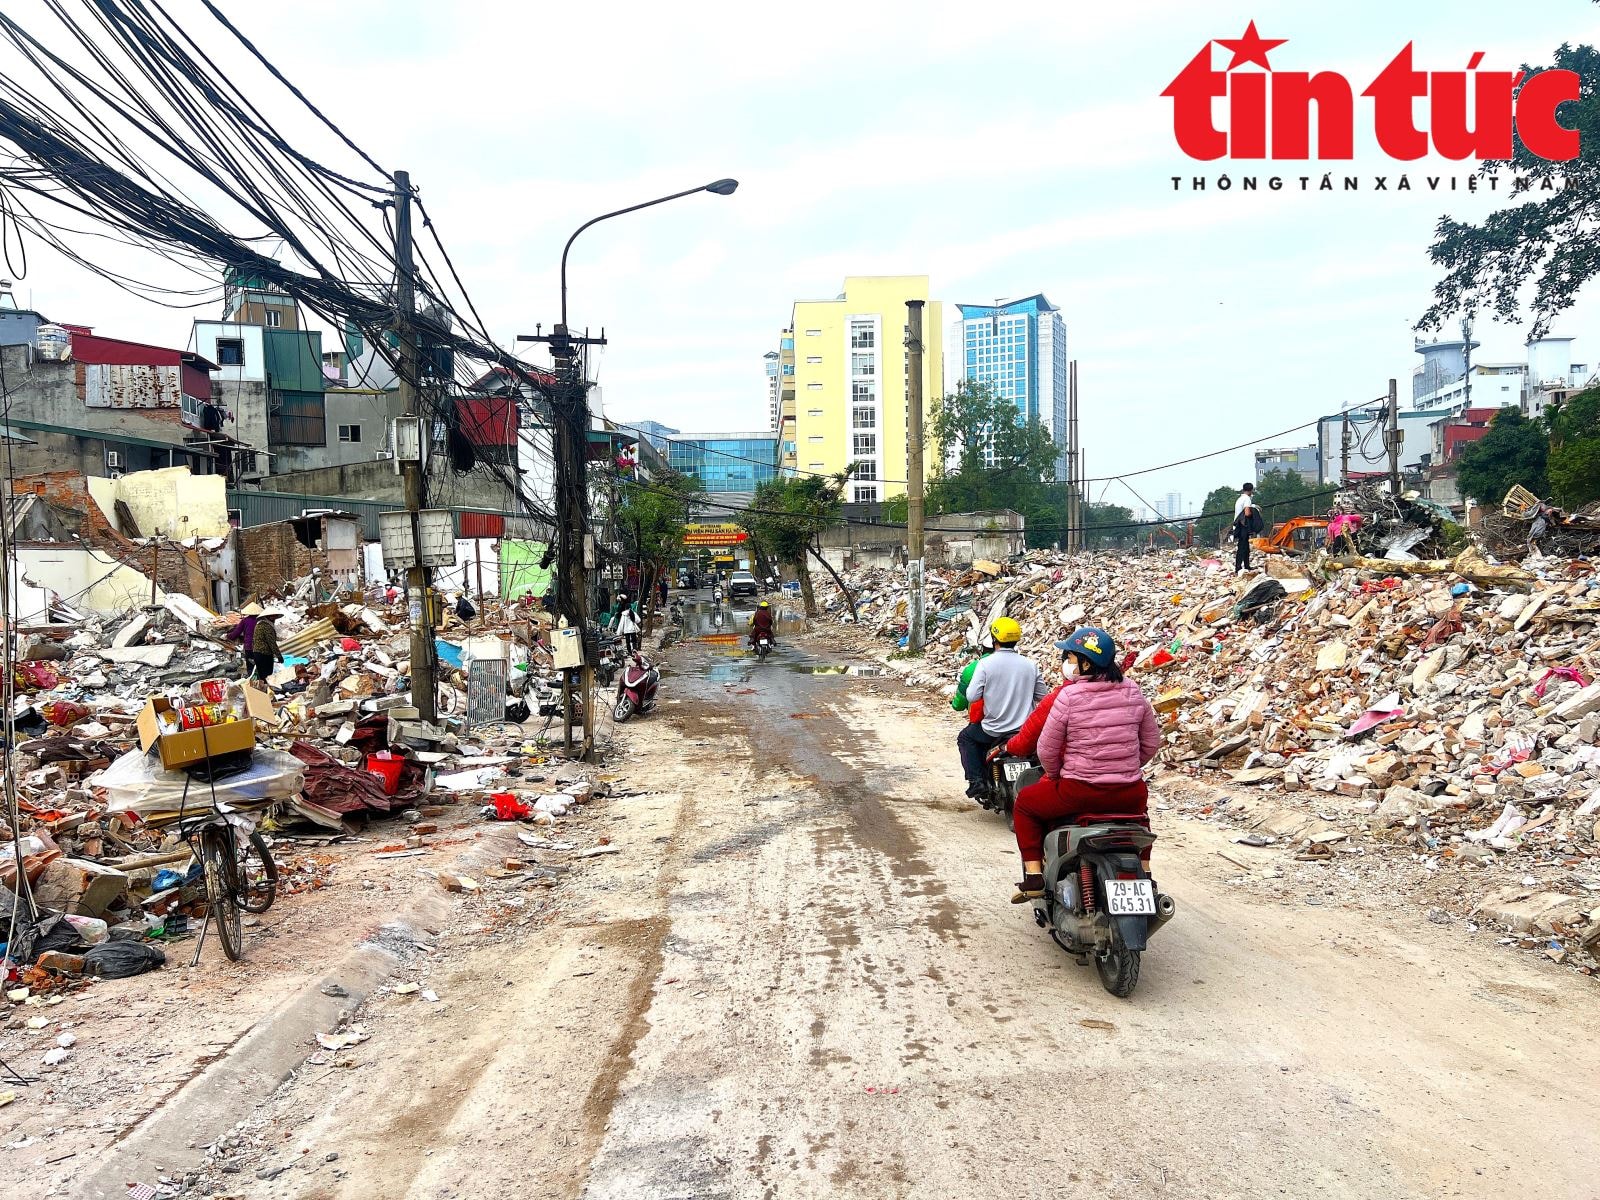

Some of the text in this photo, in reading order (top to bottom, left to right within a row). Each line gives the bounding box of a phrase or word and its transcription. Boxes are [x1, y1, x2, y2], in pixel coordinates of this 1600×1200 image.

[983, 309, 1008, 318] TASECO
[1112, 882, 1146, 897] 29-AC
[1111, 897, 1152, 912] 645.31
